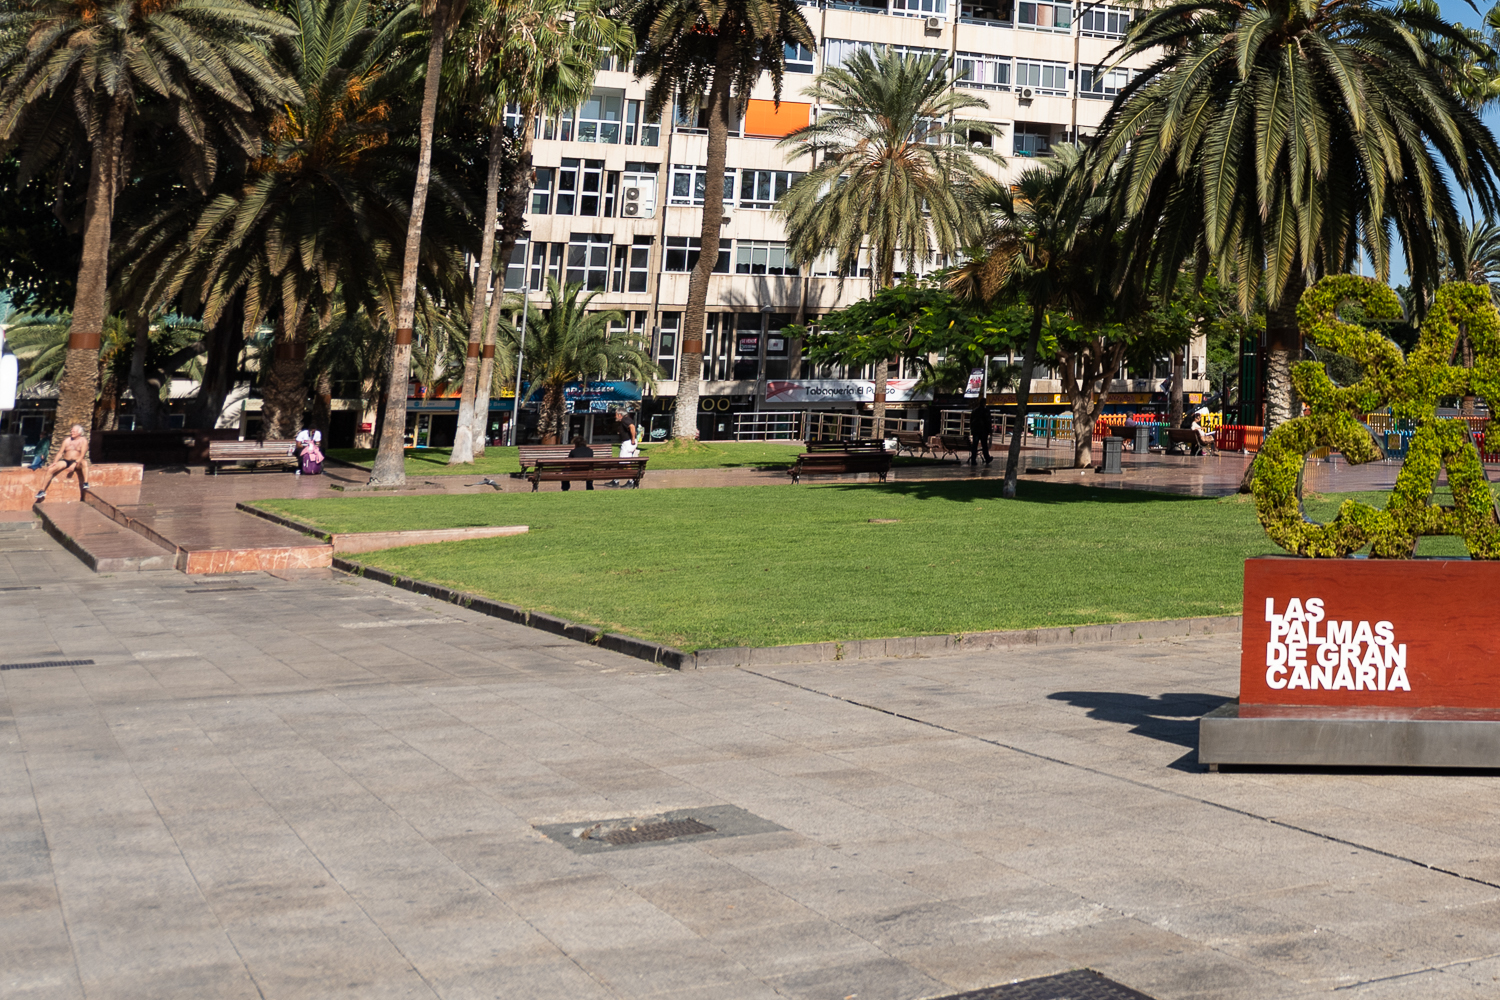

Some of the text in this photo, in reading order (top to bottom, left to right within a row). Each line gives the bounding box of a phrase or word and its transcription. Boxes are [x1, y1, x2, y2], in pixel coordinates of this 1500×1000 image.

[805, 385, 854, 397] Tabaquería
[1032, 395, 1048, 403] BAR
[660, 398, 730, 411] TAOO
[1265, 597, 1325, 622] LAS
[1270, 619, 1395, 646] PALMAS
[1266, 642, 1407, 668] DE GRAN
[1265, 665, 1412, 691] CANARIA
